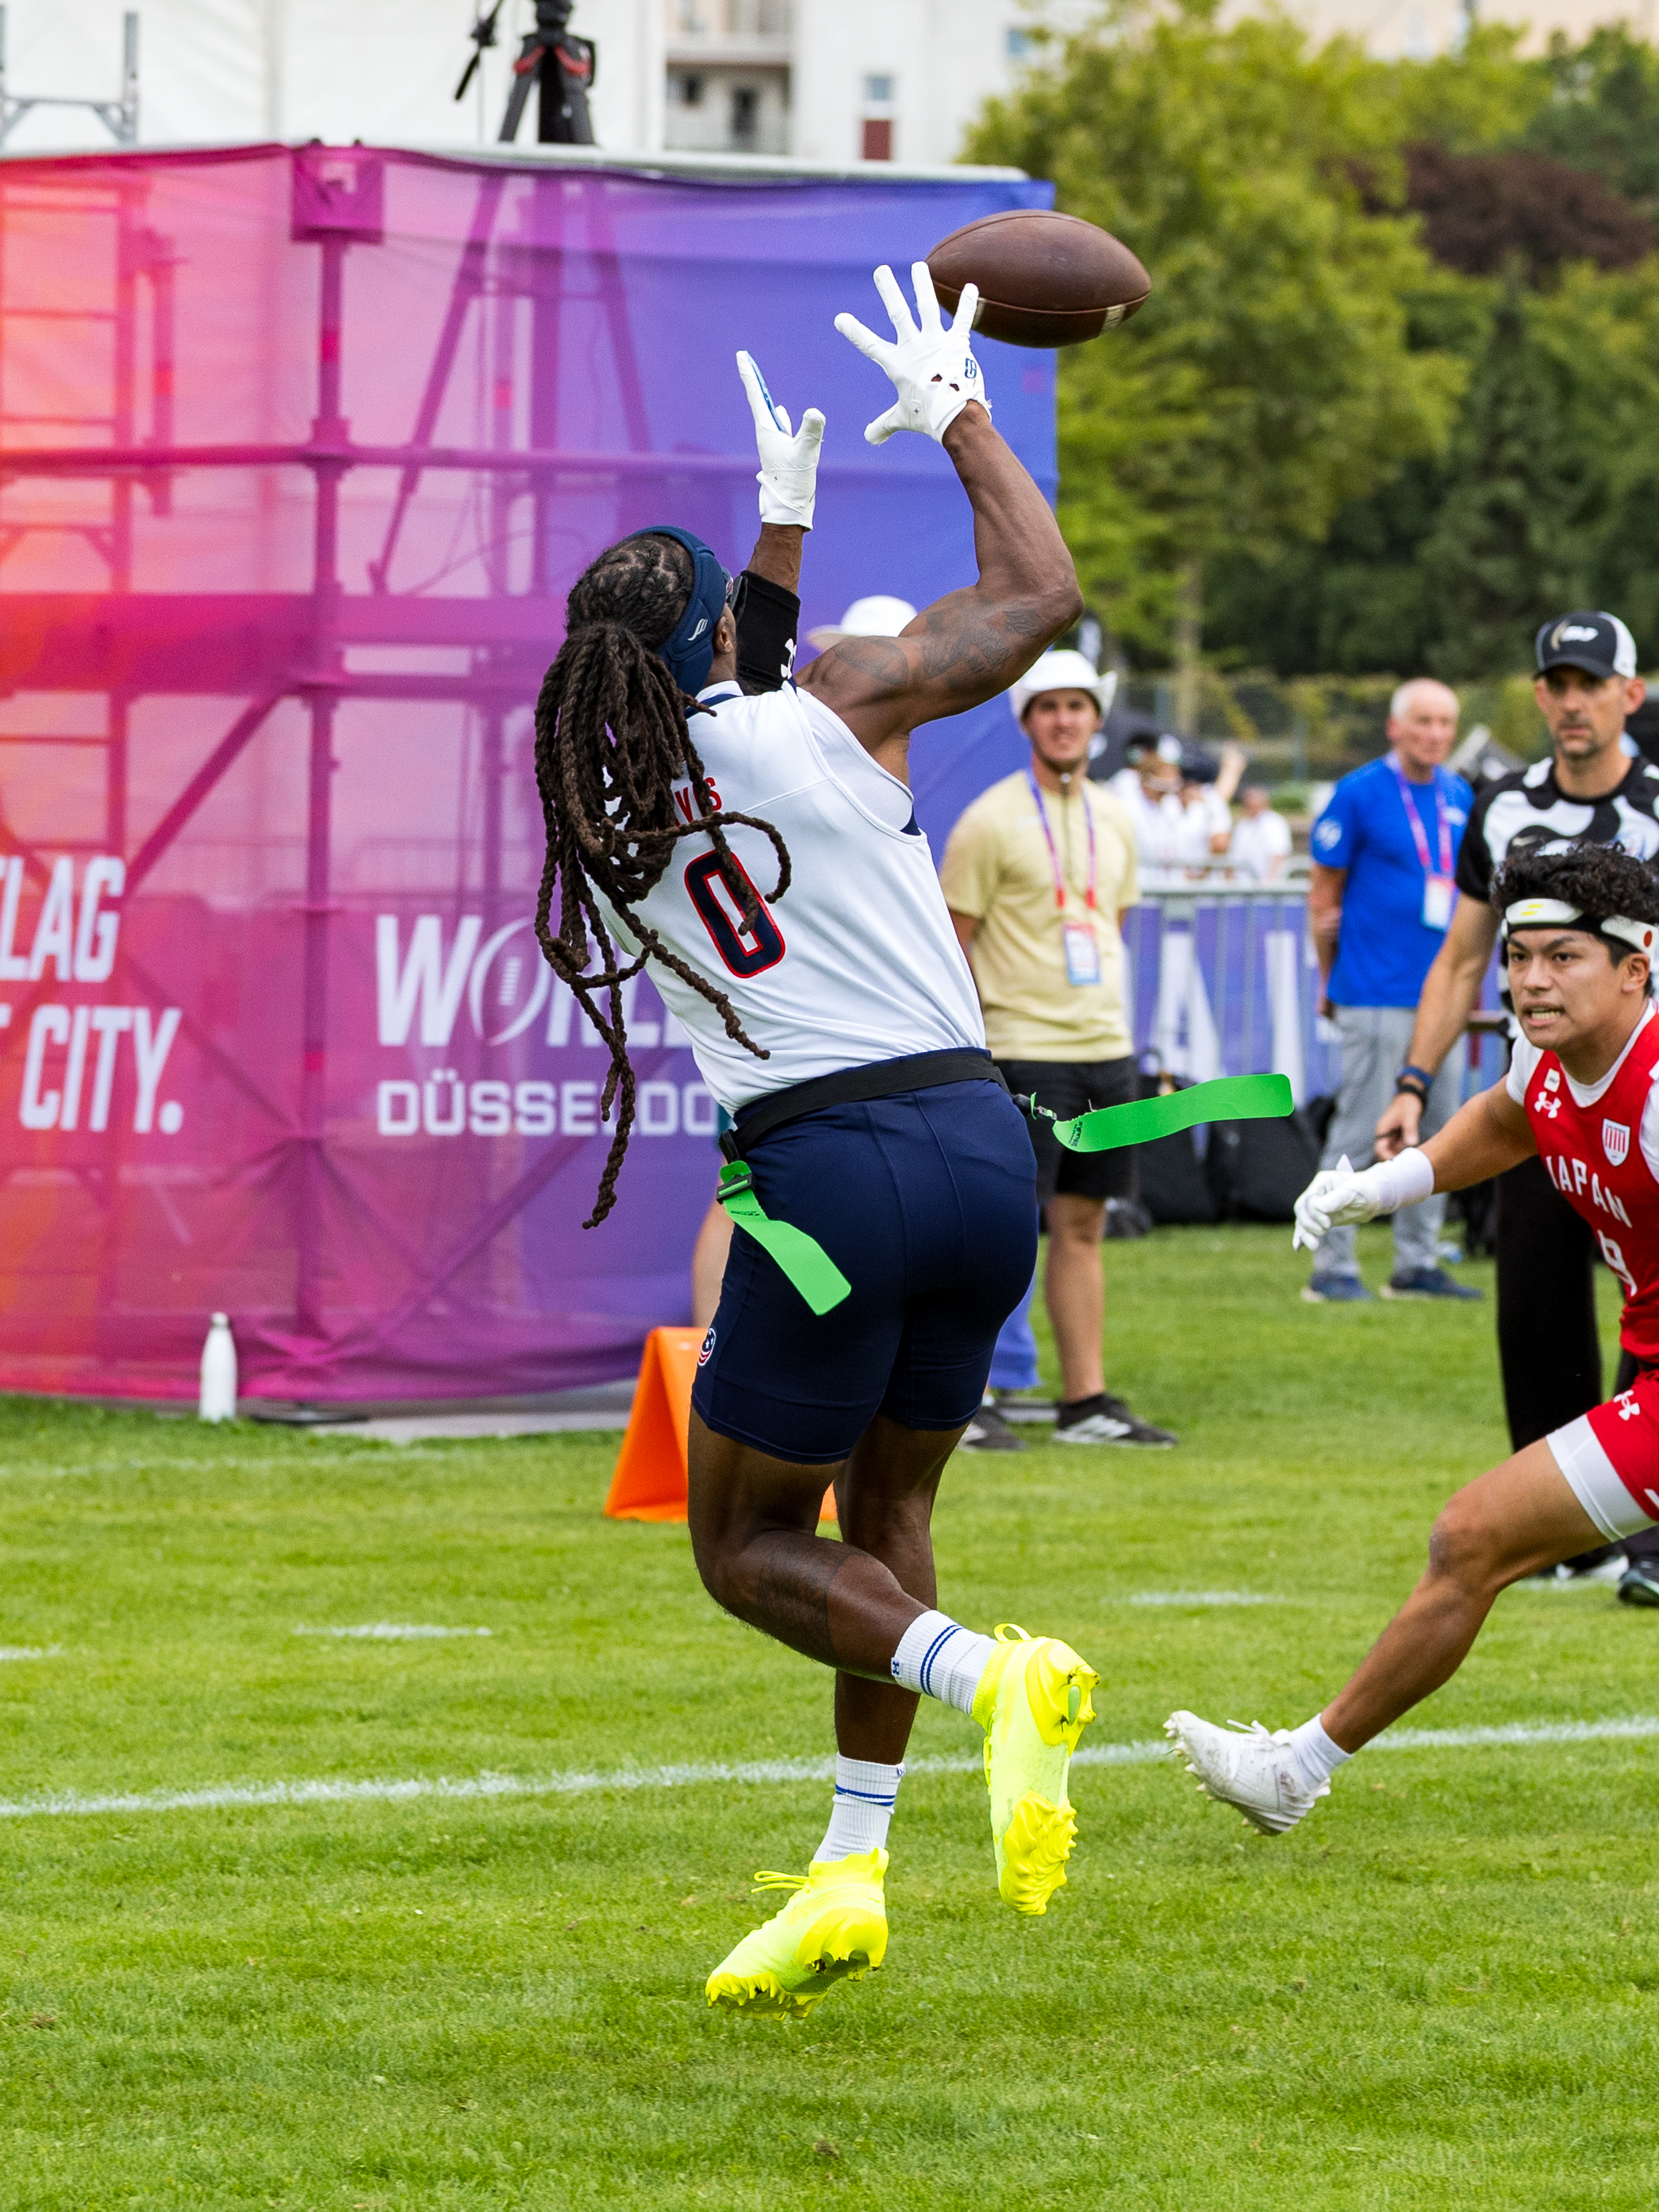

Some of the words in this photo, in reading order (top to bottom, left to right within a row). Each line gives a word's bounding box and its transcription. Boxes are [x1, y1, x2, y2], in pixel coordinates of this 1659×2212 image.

[0, 854, 126, 983] LAG
[684, 850, 785, 979] 0
[19, 1004, 184, 1135] CITY.
